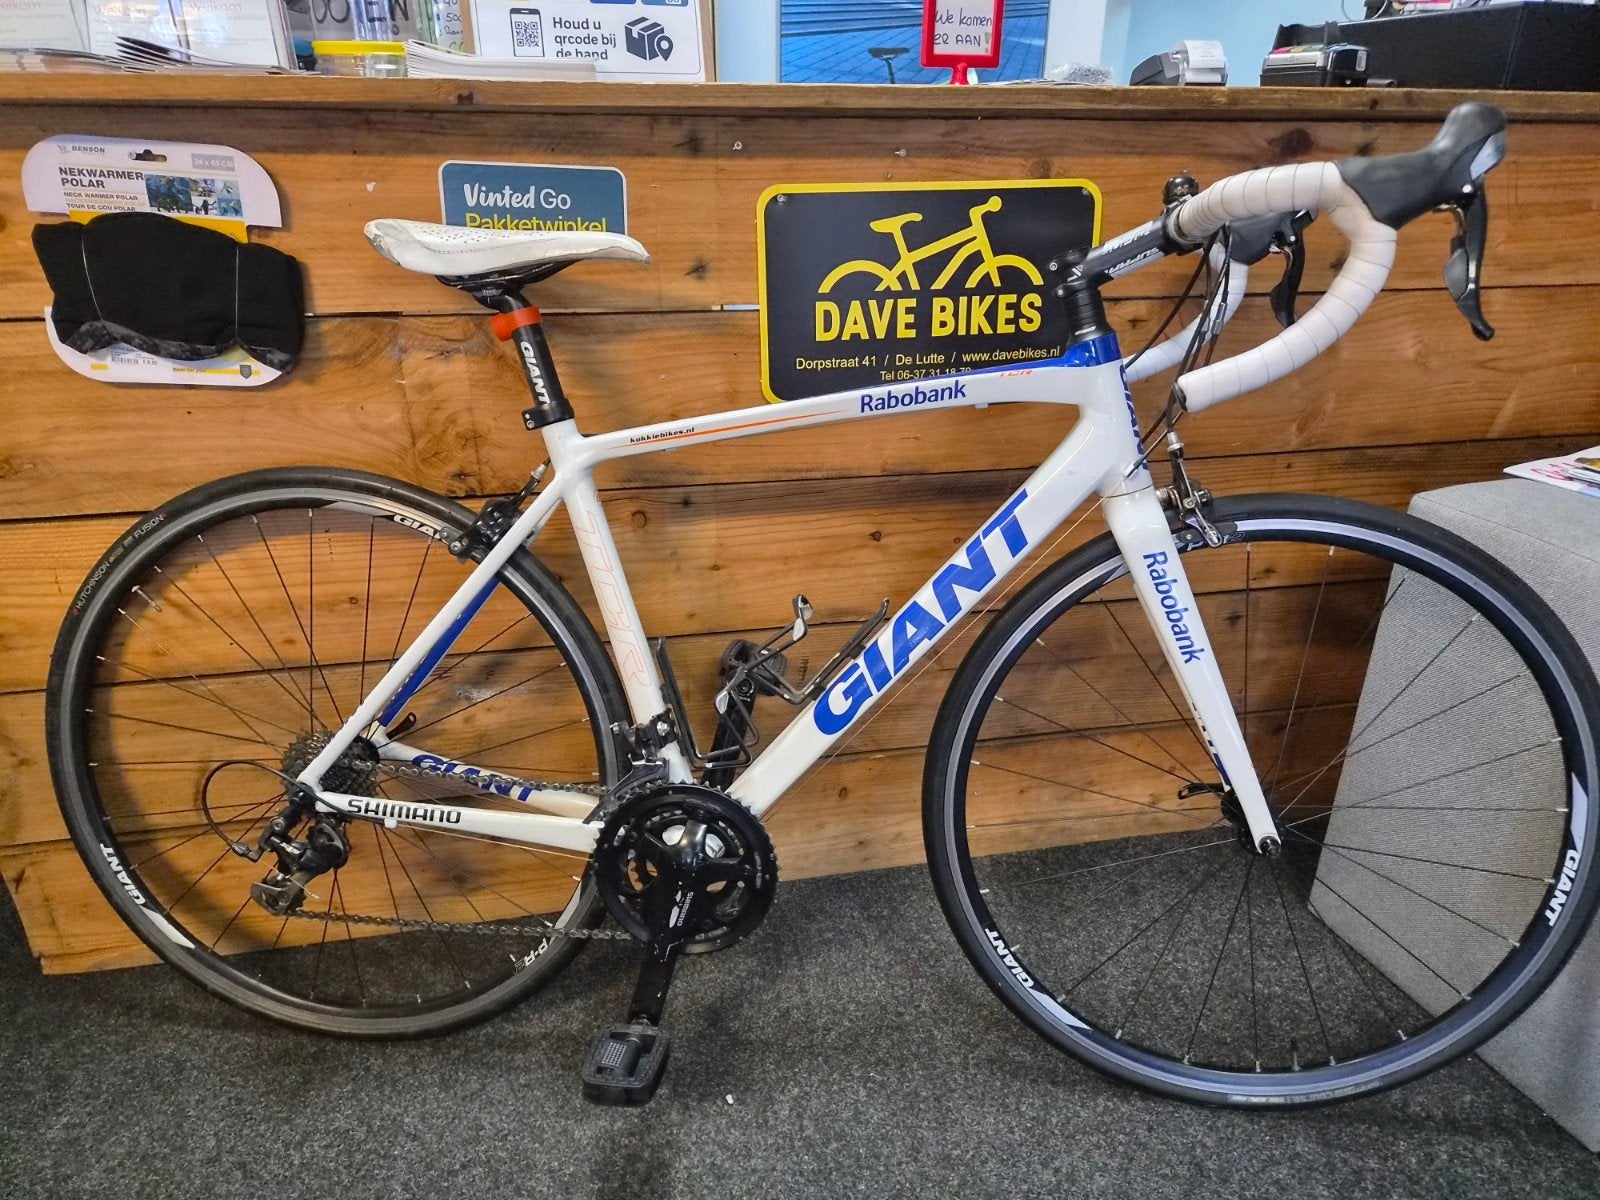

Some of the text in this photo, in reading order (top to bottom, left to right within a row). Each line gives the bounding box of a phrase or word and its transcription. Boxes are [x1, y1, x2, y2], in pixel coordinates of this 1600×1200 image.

[553, 17, 602, 30] Houd u
[959, 8, 992, 26] komen
[554, 34, 617, 48] qrcode bij
[955, 34, 981, 47] AAN
[556, 48, 608, 60] de hand
[71, 145, 105, 153] BENSON
[59, 166, 144, 180] NEKWARMER
[61, 178, 105, 188] POLAR
[463, 183, 571, 210] Vinted Go
[465, 213, 607, 233] Pakketwinkel
[815, 293, 1042, 342] DAVE BIKES
[796, 356, 859, 371] Dorpstraat
[862, 355, 877, 367] 41
[896, 354, 912, 366] De
[916, 353, 945, 365] Lutte
[962, 346, 1060, 363] www.davebikes.nl
[520, 341, 550, 404] GIANT
[880, 370, 895, 380] Tel
[860, 380, 966, 413] Rabobank
[630, 427, 695, 443] kokkiebikes.nl
[75, 515, 164, 609] HUTCHINSON FUSION
[814, 488, 1029, 735] GIANT
[1142, 551, 1205, 664] Rabobank
[347, 799, 462, 824] SHIMANO
[100, 843, 146, 905] GIANT
[1544, 849, 1580, 927] GIANT
[677, 891, 694, 927] SHIMANO
[984, 928, 1034, 989] GIANT
